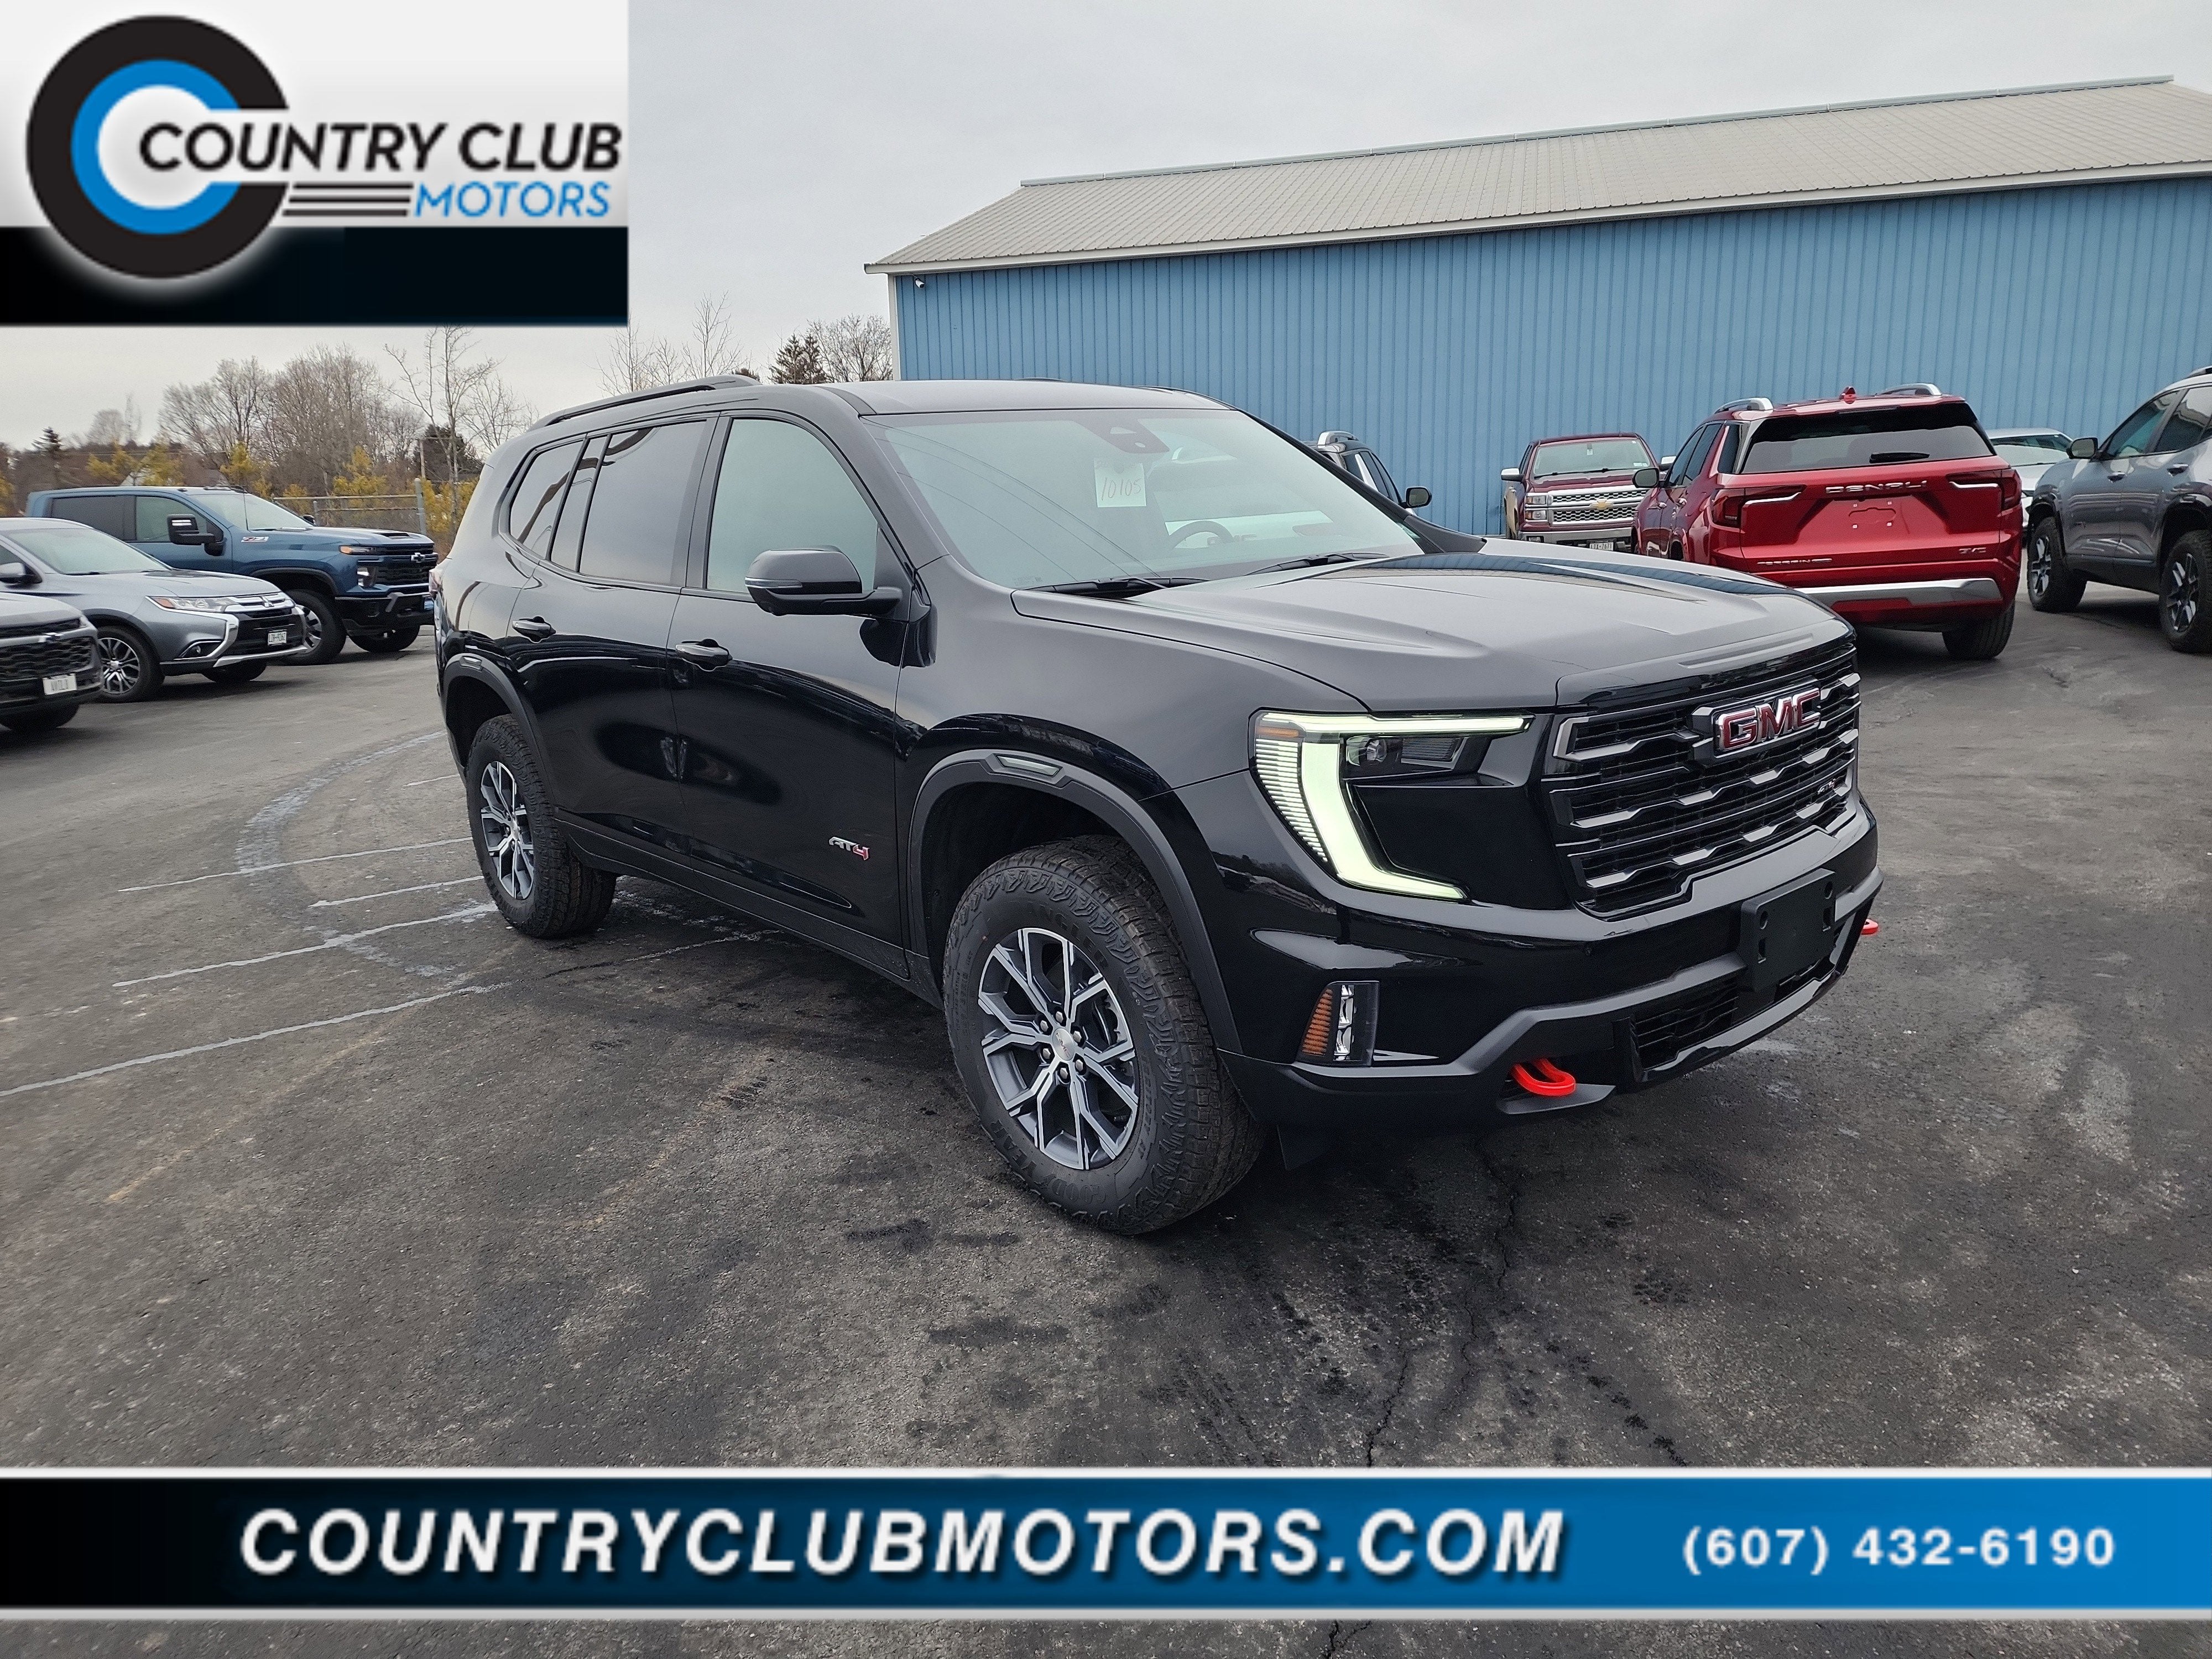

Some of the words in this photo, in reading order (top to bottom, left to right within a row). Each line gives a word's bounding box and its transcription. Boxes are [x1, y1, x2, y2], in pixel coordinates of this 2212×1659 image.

[1101, 477, 1141, 501] 10105
[1825, 480, 1927, 494] DENALI
[1719, 688, 1821, 751] GMC
[828, 836, 869, 860] AT4
